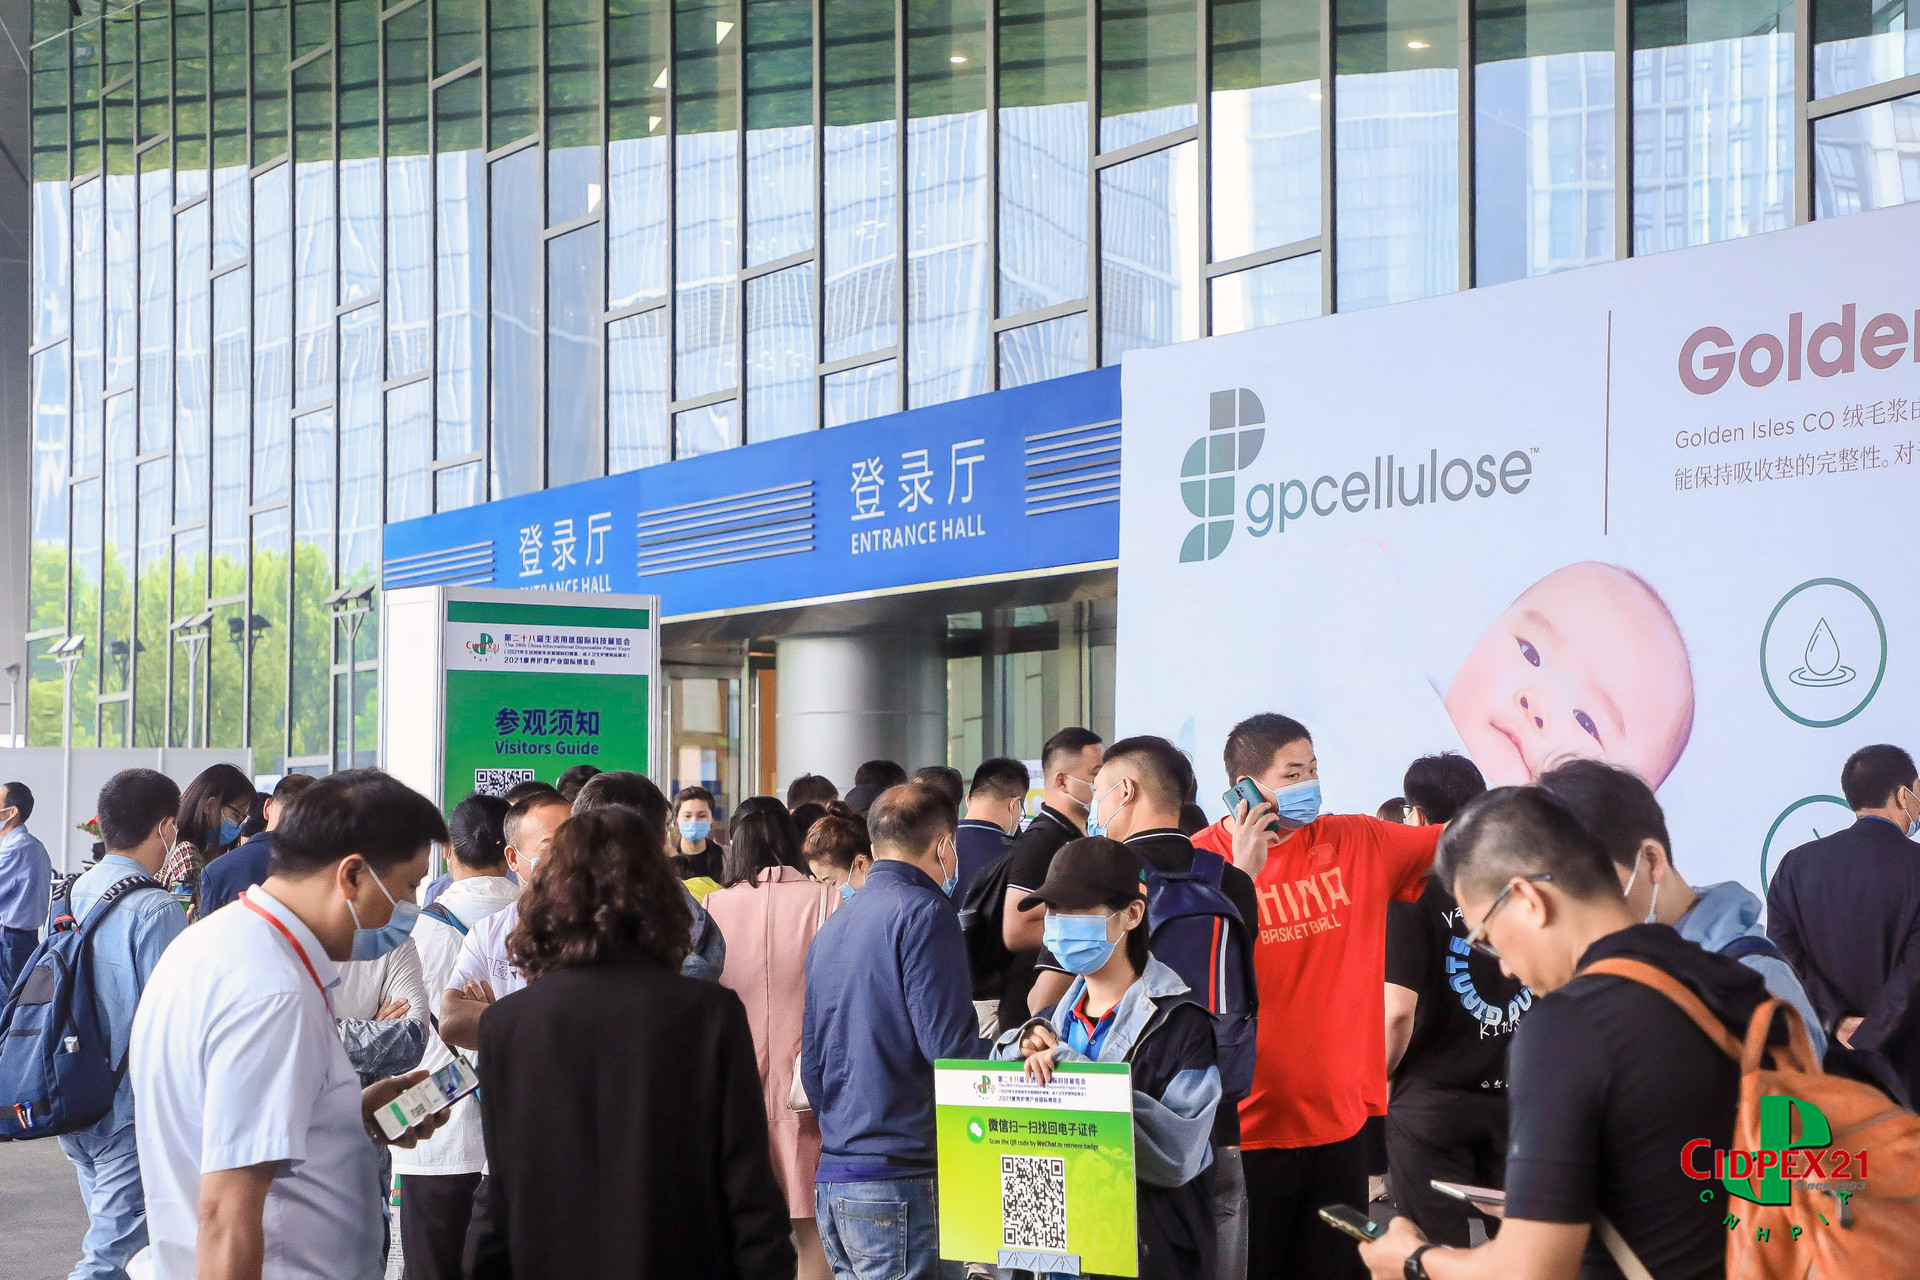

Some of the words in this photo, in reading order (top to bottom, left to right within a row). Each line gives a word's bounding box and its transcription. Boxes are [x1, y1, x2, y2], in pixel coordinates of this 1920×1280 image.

[1678, 303, 1920, 395] Golde
[1675, 425, 1744, 449] Golden
[1752, 418, 1795, 440] Isles
[1802, 411, 1835, 433] CO
[850, 438, 985, 522] 登录厅
[1246, 448, 1533, 538] gpcellulose
[519, 511, 613, 578] 登录厅
[850, 522, 936, 555] ENTRANCE
[940, 514, 986, 543] HALL
[520, 578, 579, 592] ANCE
[581, 574, 612, 593] HALL
[495, 707, 600, 736] 参观须知
[495, 740, 551, 755] Visitors
[555, 741, 600, 756] Guide
[1256, 866, 1352, 927] HINA
[1260, 913, 1342, 946] BASKETBALL
[988, 1118, 1098, 1137] 微信扫一扫找回电子证件
